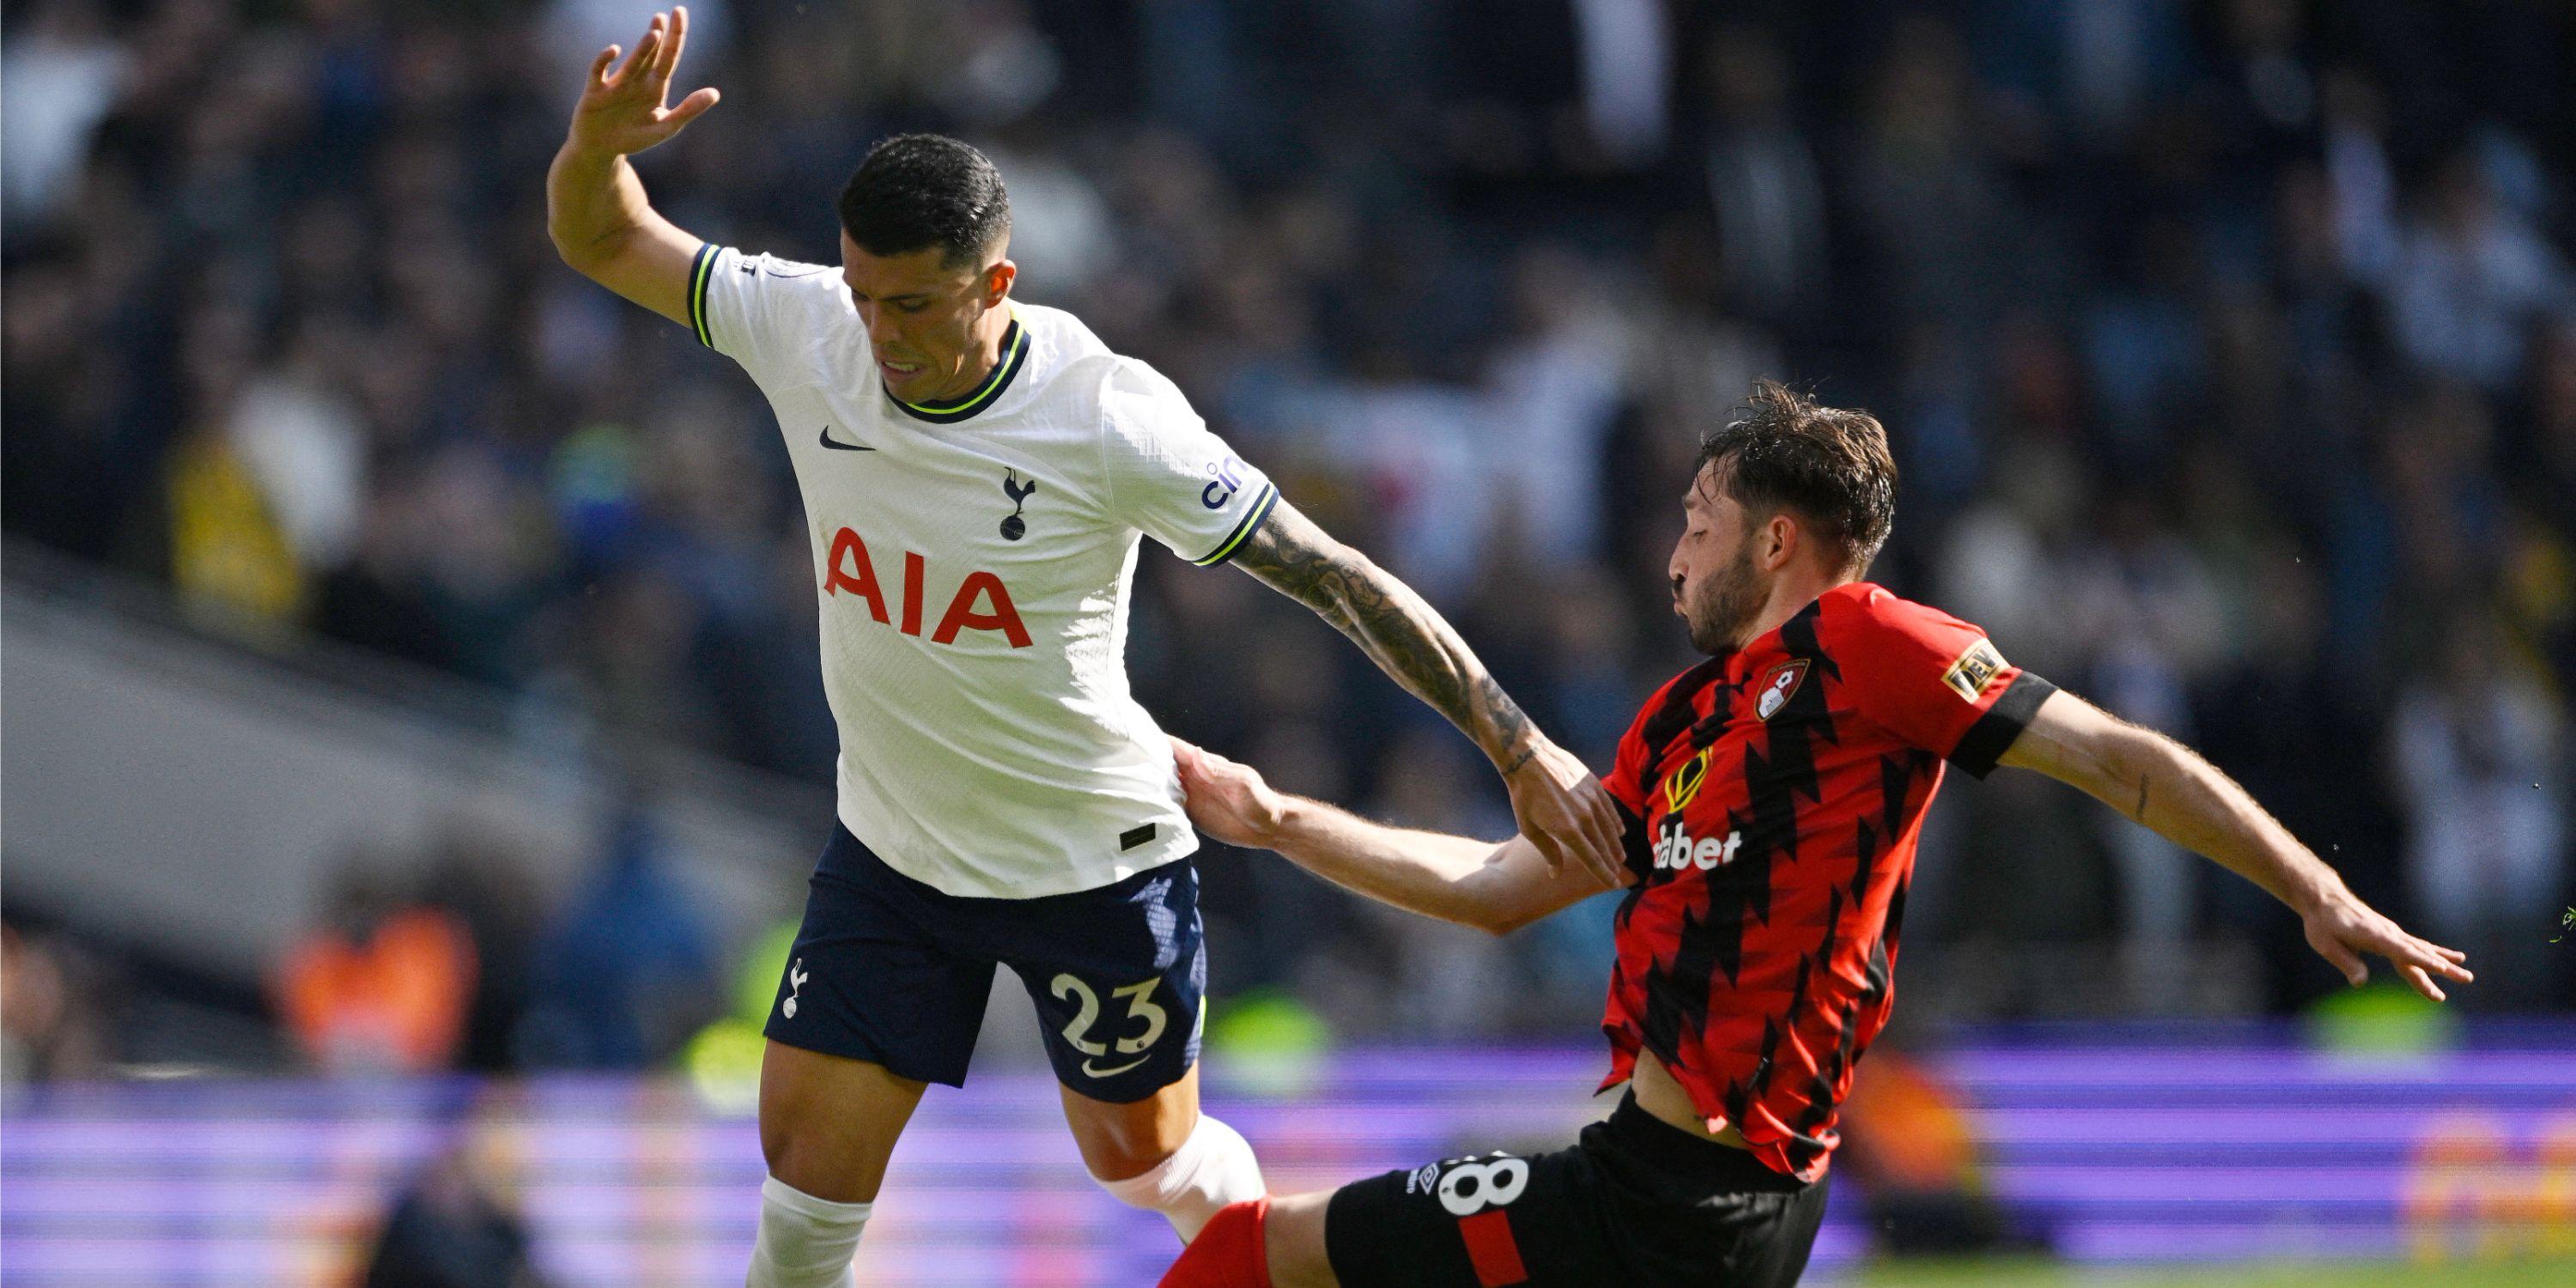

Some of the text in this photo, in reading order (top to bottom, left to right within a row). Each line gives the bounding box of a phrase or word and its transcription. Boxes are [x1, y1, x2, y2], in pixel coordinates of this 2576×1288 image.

[823, 526, 1034, 649] AIA
[1051, 973, 1167, 1057] 23
[1437, 1151, 1529, 1216] 8
